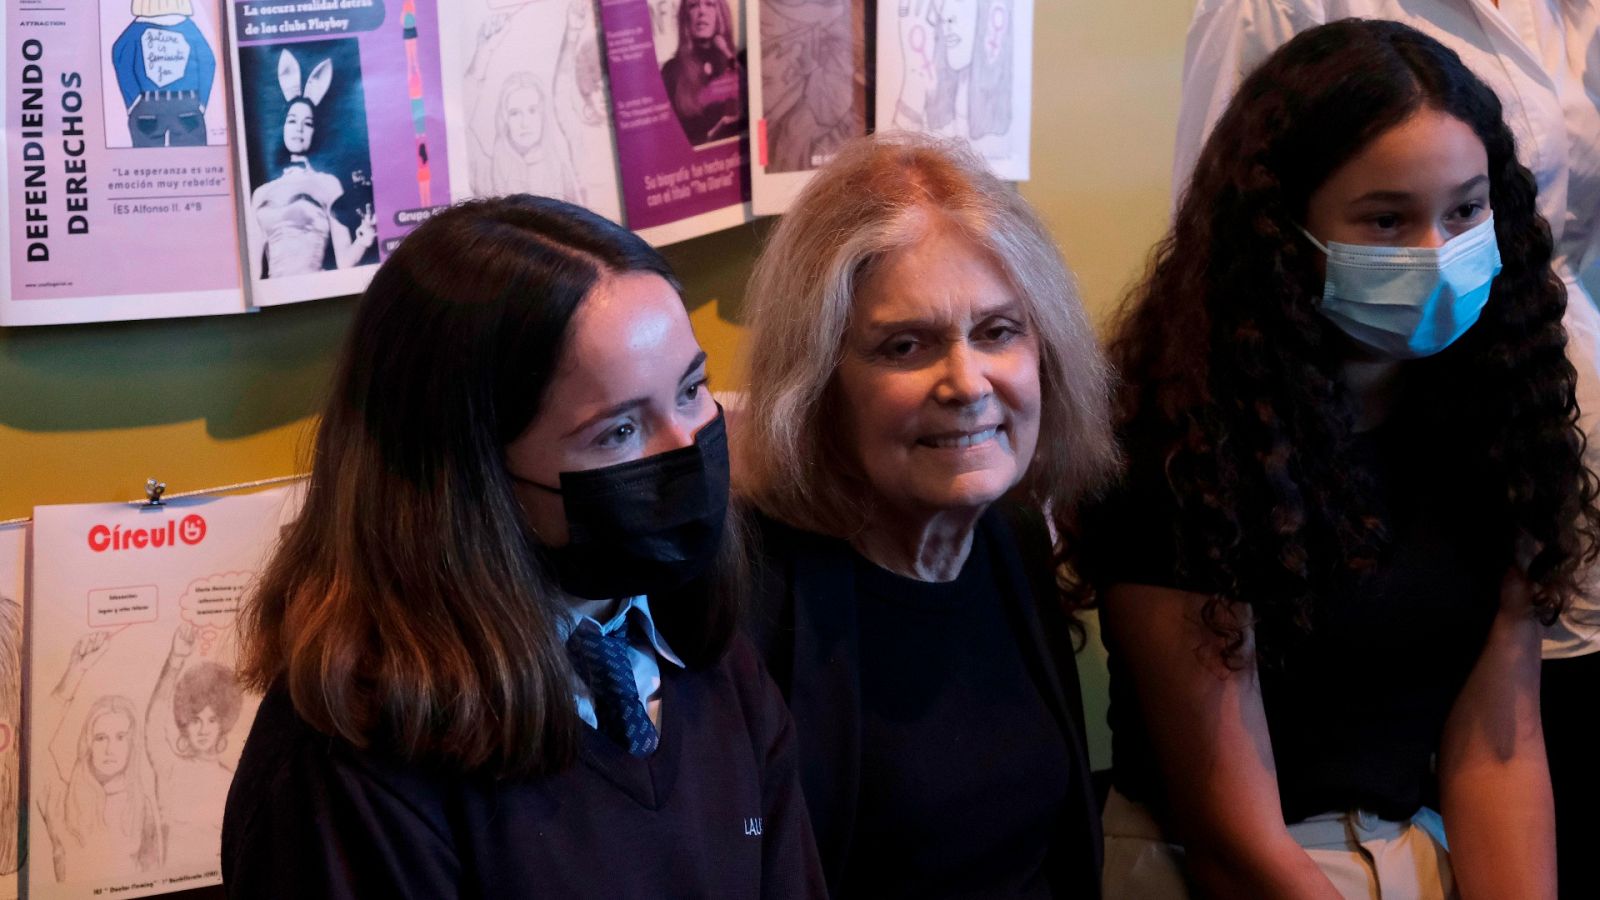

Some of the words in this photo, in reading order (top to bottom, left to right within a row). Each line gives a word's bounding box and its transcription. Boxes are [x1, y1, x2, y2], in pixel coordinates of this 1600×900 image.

[243, 5, 259, 16] La
[260, 4, 296, 15] oscura
[297, 0, 339, 12] realidad
[244, 23, 260, 35] de
[261, 21, 278, 33] los
[279, 19, 307, 32] clubs
[308, 16, 349, 31] Playboy
[21, 38, 50, 262] DEFENDIENDO
[60, 71, 89, 235] DERECHOS
[133, 166, 187, 178] esperanza
[191, 166, 201, 175] es
[205, 166, 225, 174] una
[107, 179, 153, 190] emoción
[157, 179, 180, 190] muy
[132, 203, 170, 214] Alfonso
